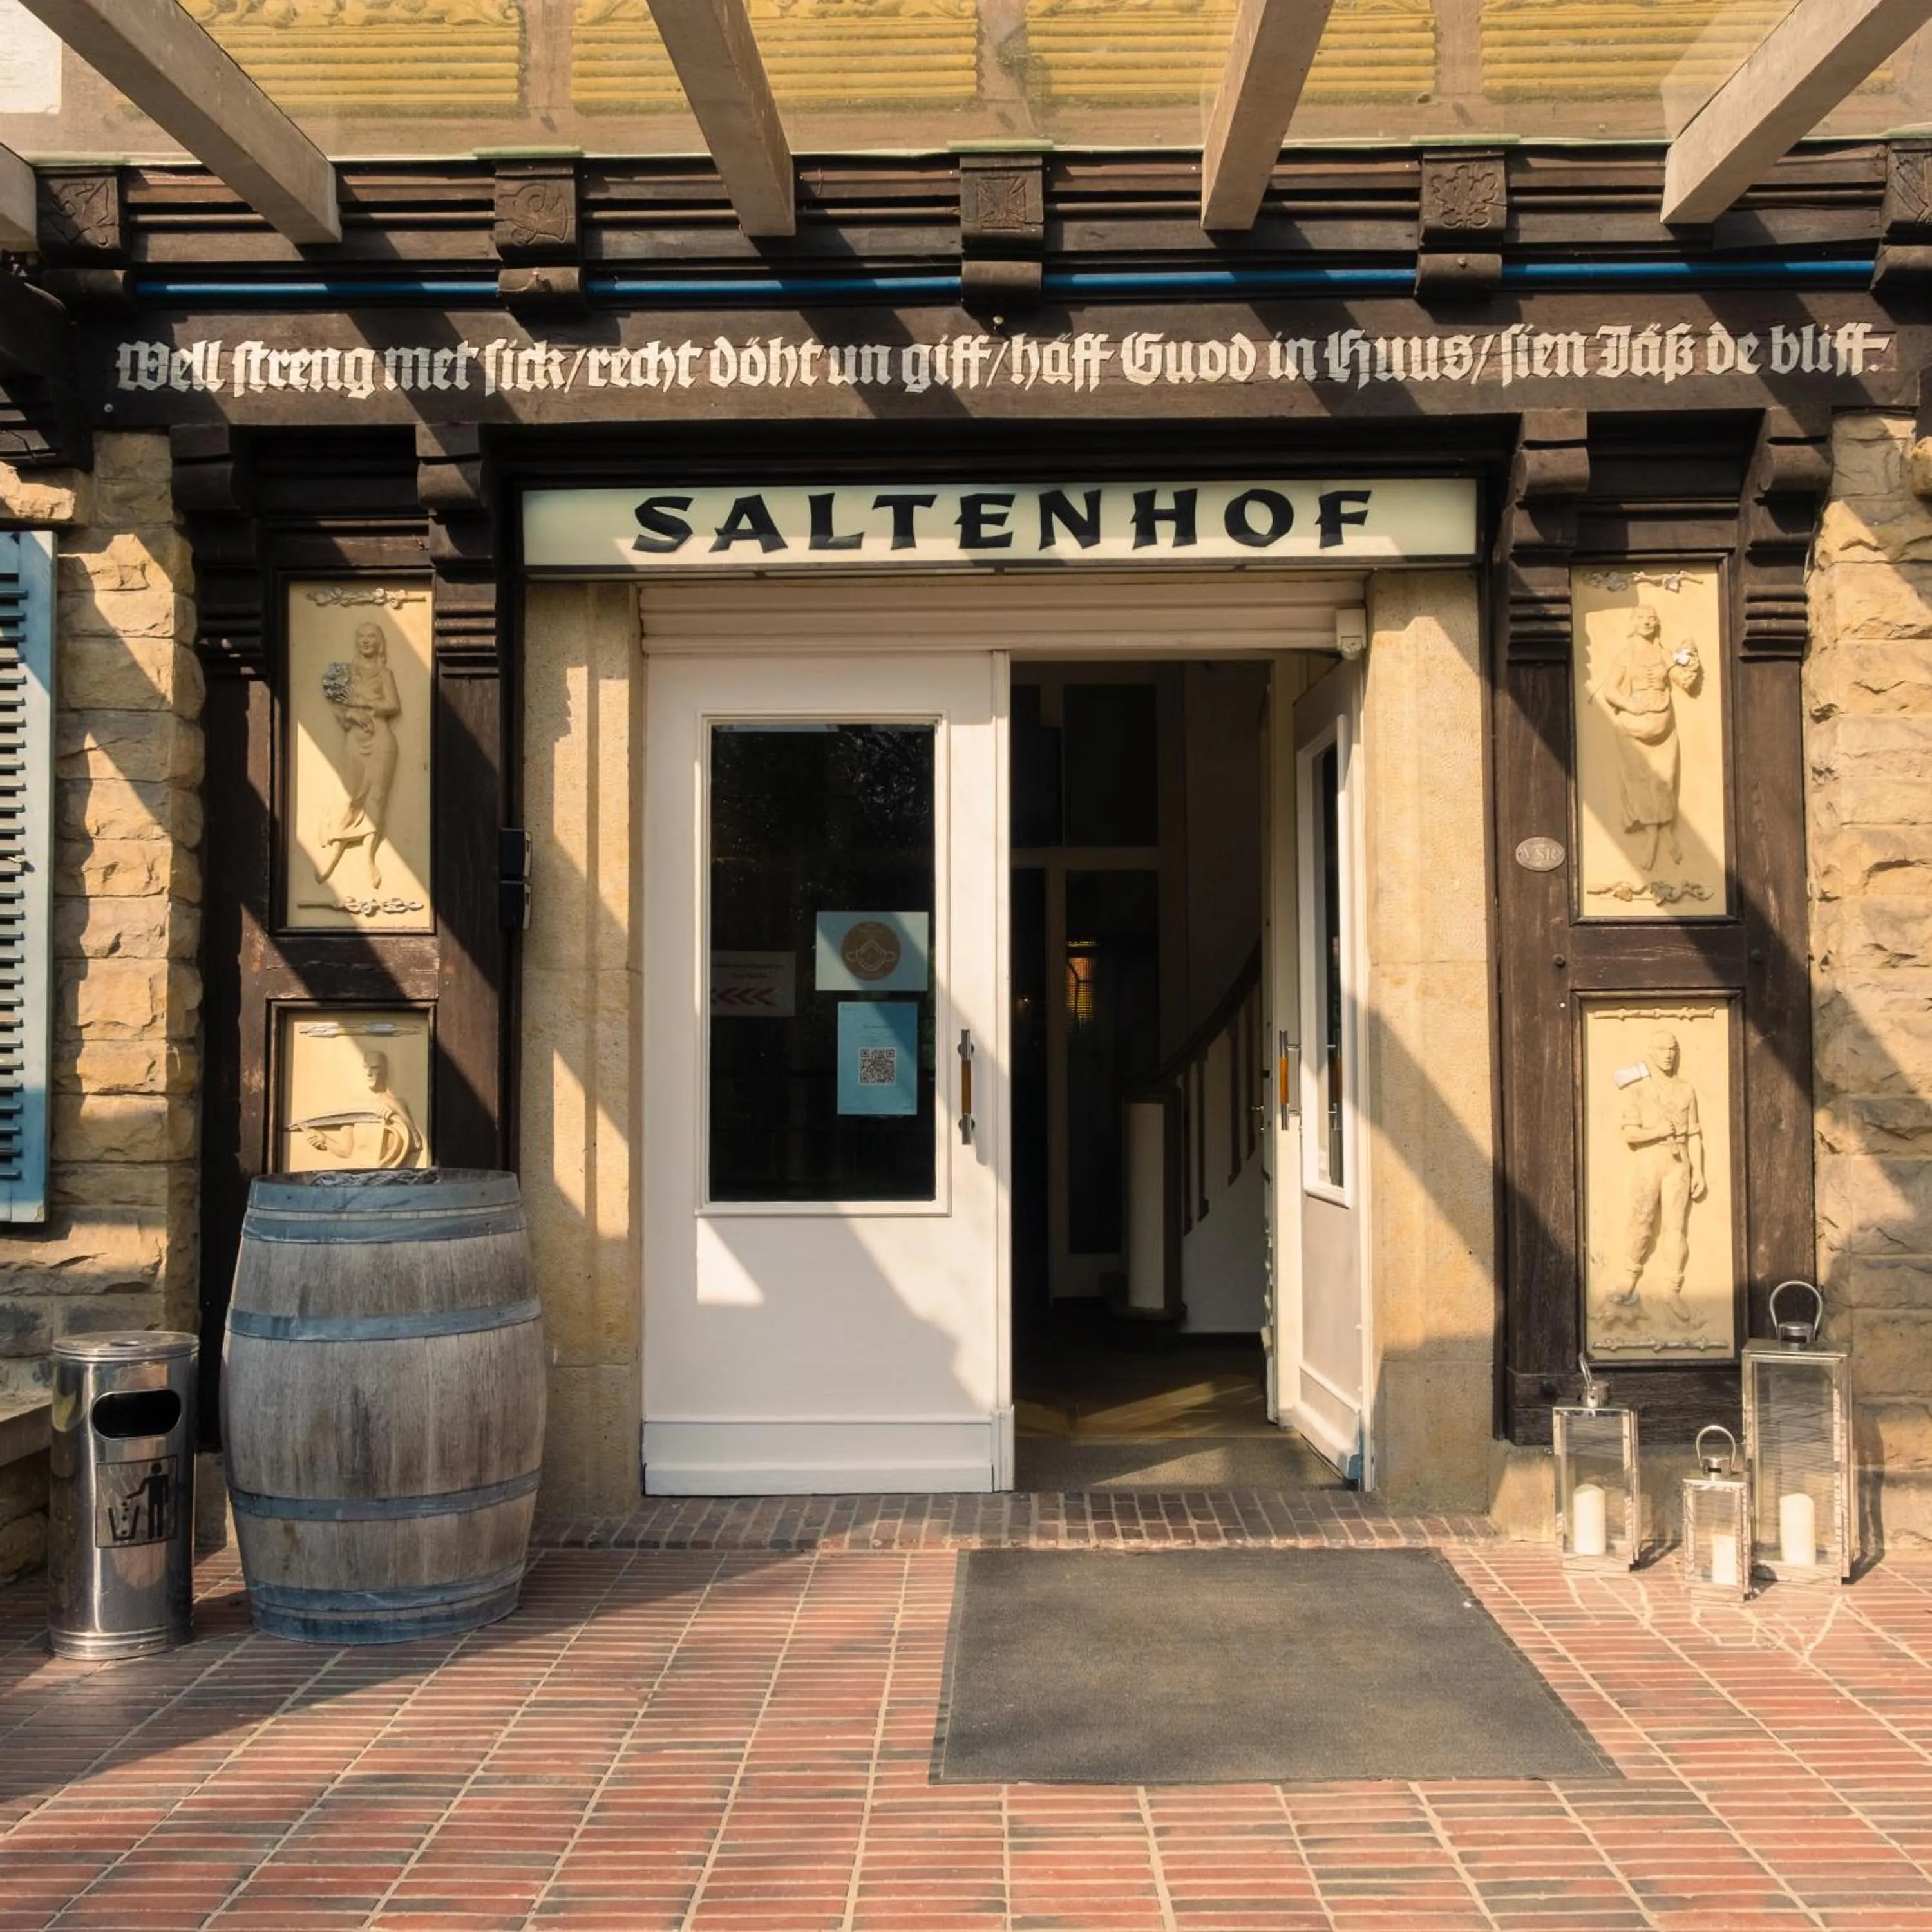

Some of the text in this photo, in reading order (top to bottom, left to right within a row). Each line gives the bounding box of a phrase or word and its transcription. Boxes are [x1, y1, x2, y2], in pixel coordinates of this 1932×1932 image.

[116, 339, 223, 390] Well
[383, 339, 479, 390] met
[828, 343, 891, 385] un
[1268, 331, 1318, 382] in
[1707, 321, 1762, 375] de
[632, 488, 1372, 553] SALTENHOF
